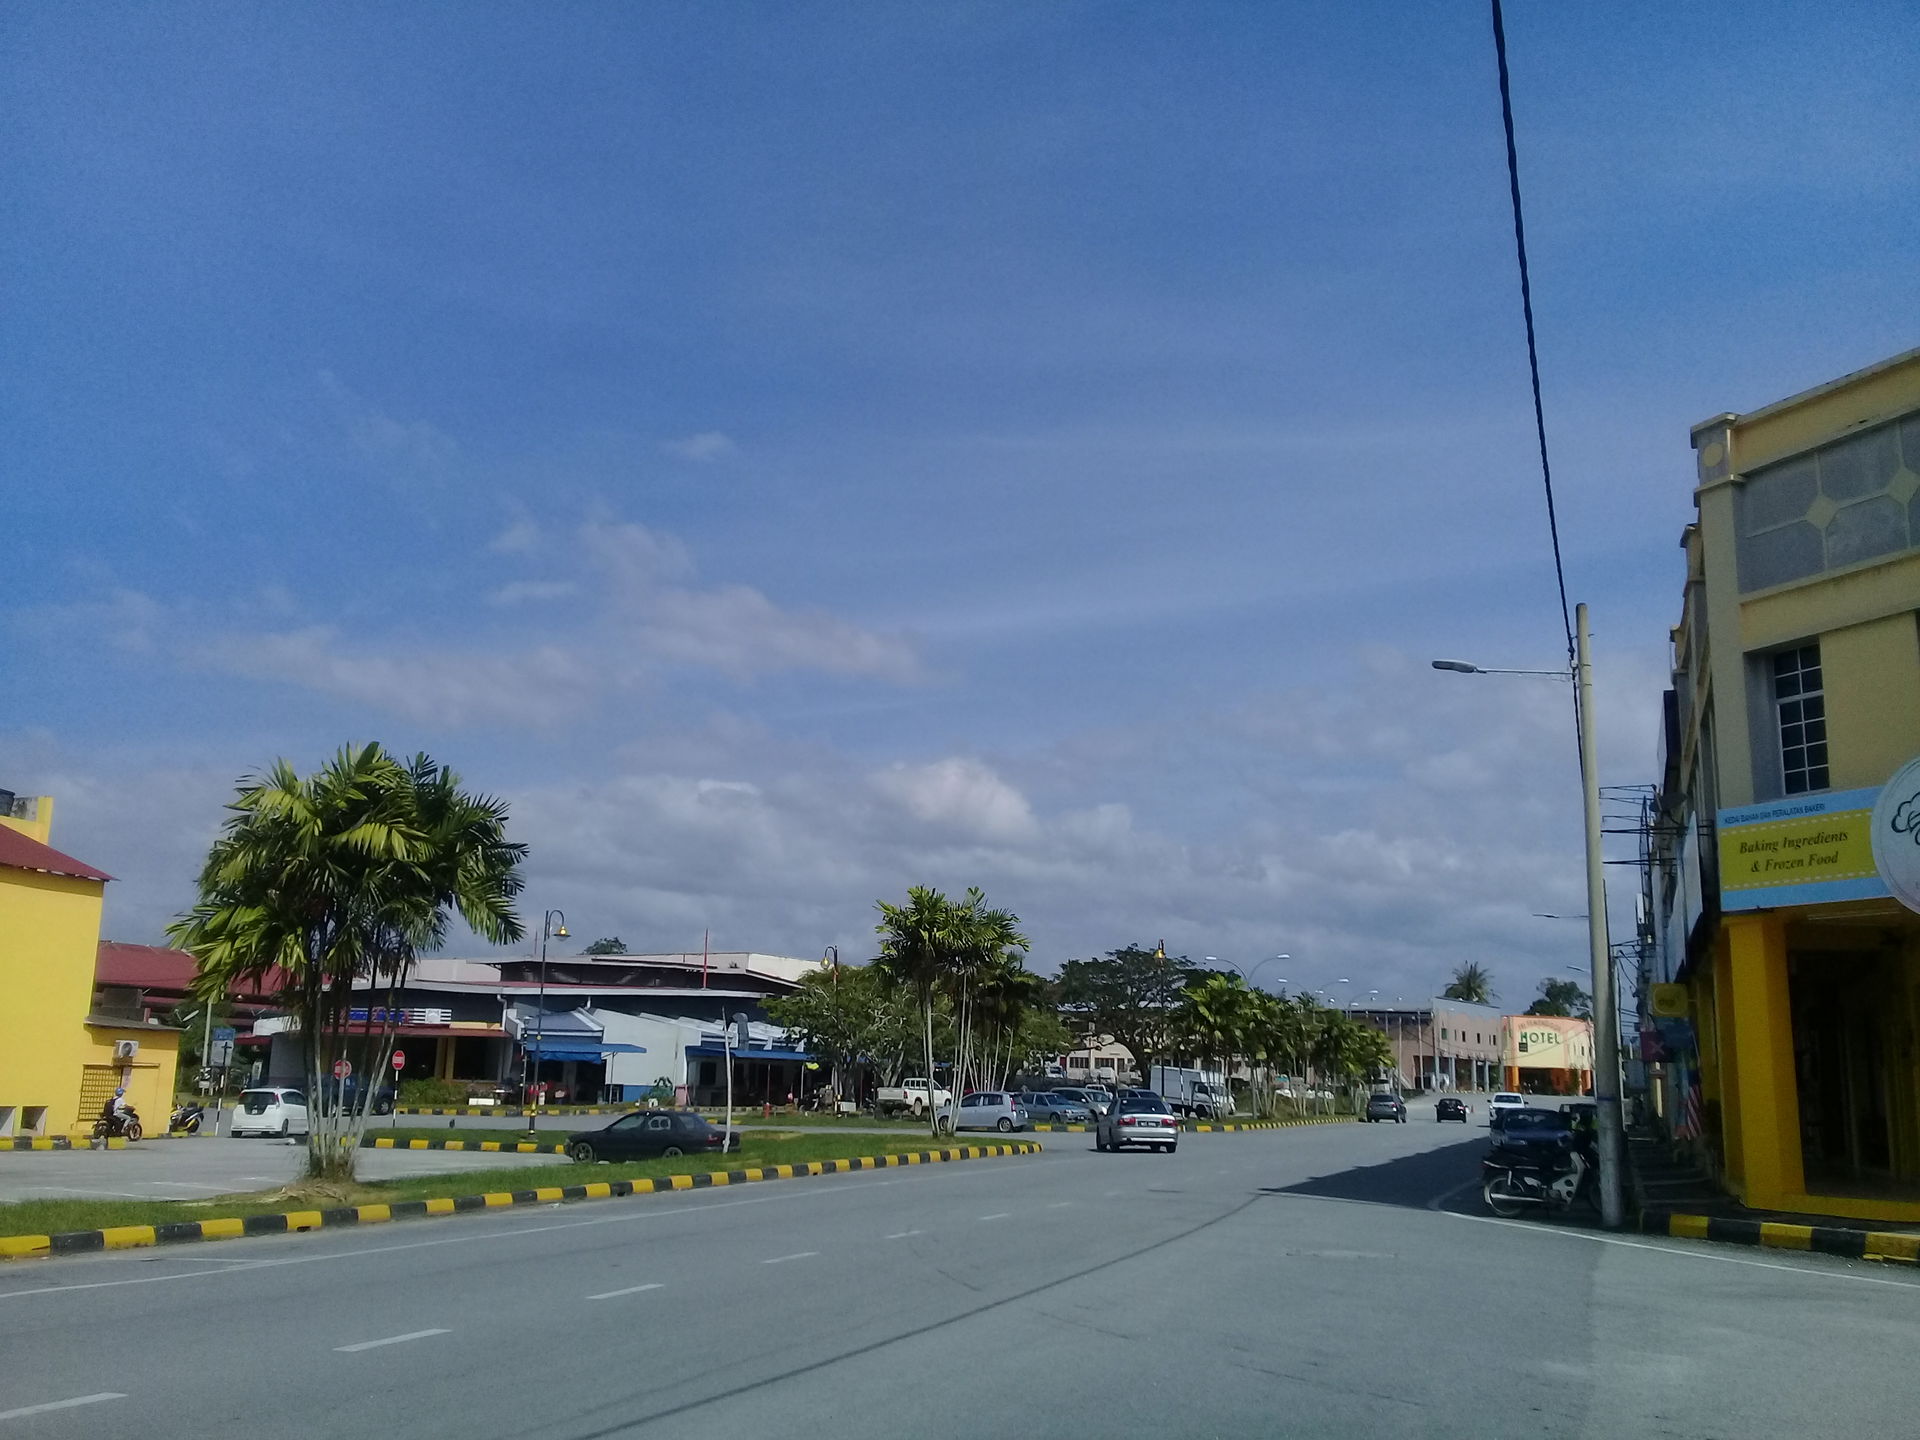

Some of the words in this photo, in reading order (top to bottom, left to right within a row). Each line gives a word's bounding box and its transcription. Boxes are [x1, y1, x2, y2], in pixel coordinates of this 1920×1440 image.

[1739, 840, 1778, 853] Baking
[1783, 832, 1848, 848] Ingredients
[1750, 860, 1760, 873] &
[1764, 857, 1804, 872] Frozen
[1807, 850, 1839, 866] Food
[1520, 1031, 1560, 1044] HOTEL
